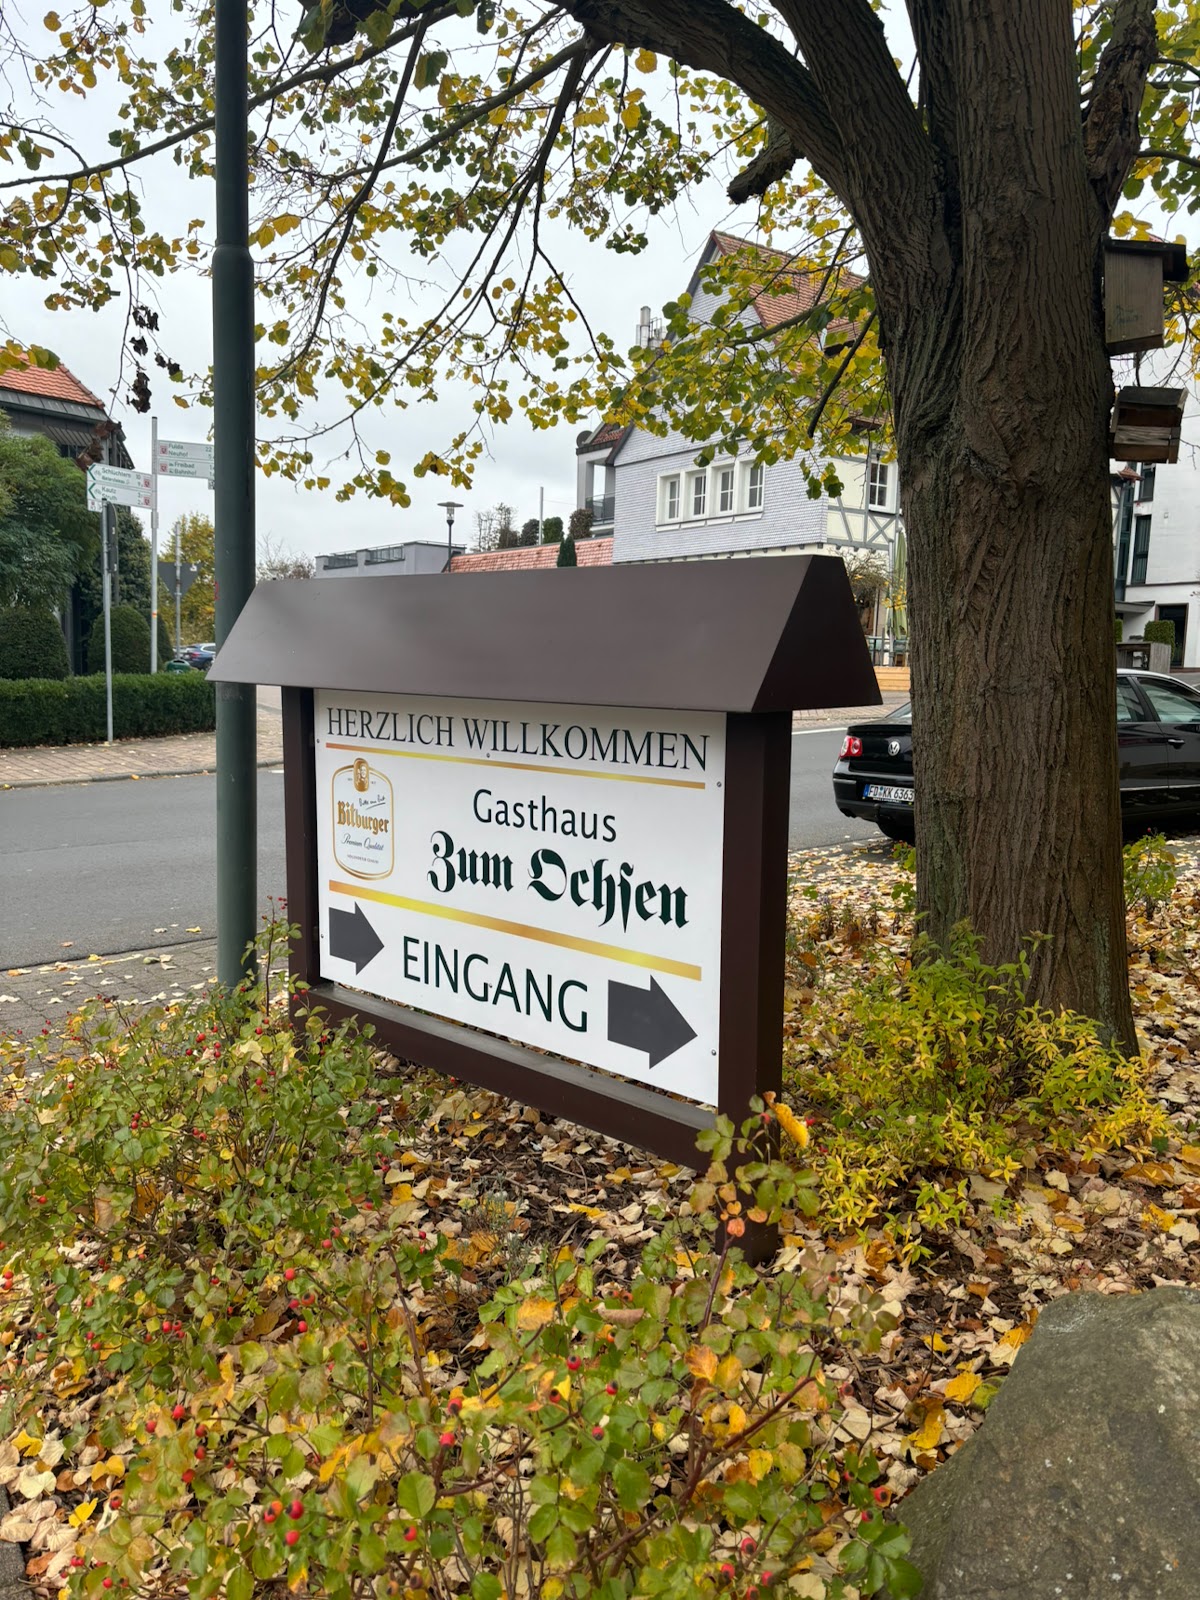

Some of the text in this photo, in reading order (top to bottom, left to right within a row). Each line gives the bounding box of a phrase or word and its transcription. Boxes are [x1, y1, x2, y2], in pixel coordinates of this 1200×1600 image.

[174, 461, 195, 469] Freibad
[174, 468, 197, 476] Bahnhof
[327, 707, 710, 772] HERZLICH WILLKOMMEN
[869, 785, 879, 796] FD
[893, 788, 914, 800] 6363
[337, 800, 389, 835] Bitburger
[473, 788, 617, 842] Gasthaus
[427, 830, 514, 893] Zum
[403, 935, 588, 1033] EINGANG
